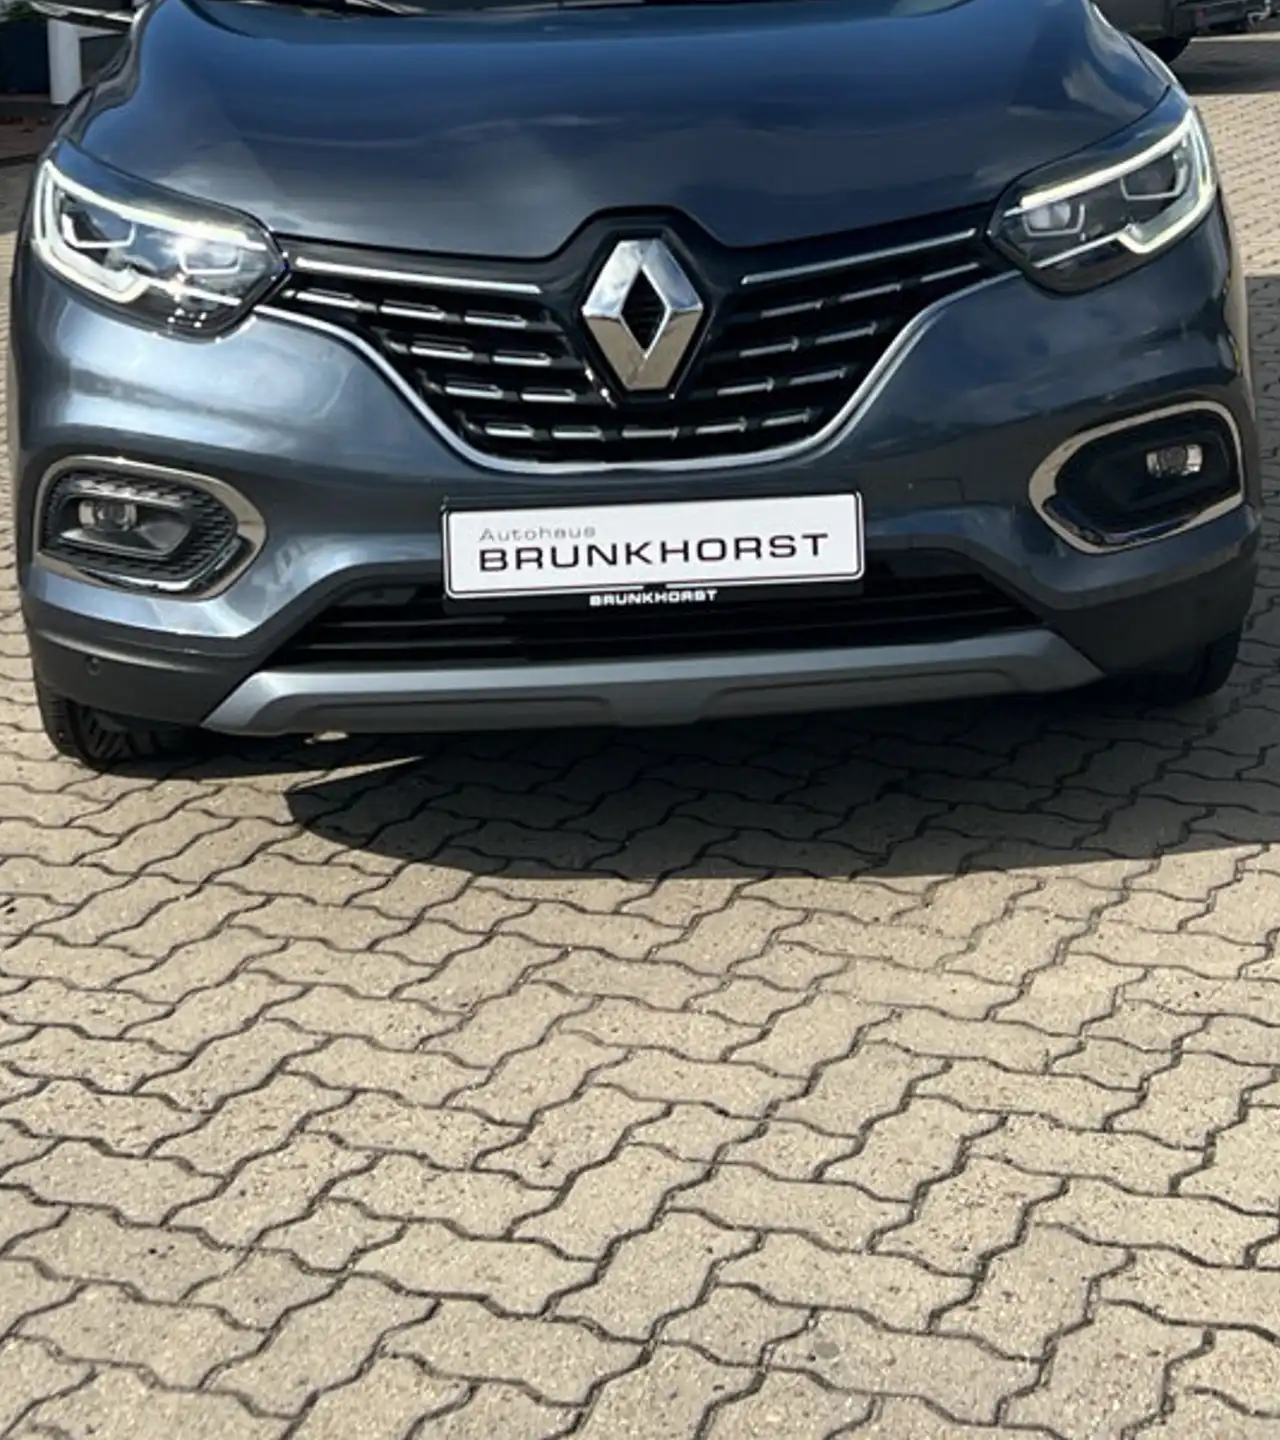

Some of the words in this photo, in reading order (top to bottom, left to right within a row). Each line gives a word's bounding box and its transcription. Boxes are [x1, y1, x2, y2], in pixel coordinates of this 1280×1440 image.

[478, 526, 597, 542] Autohaus
[478, 533, 828, 572] BRUNKHORST
[589, 588, 718, 607] BRUNKHORST
